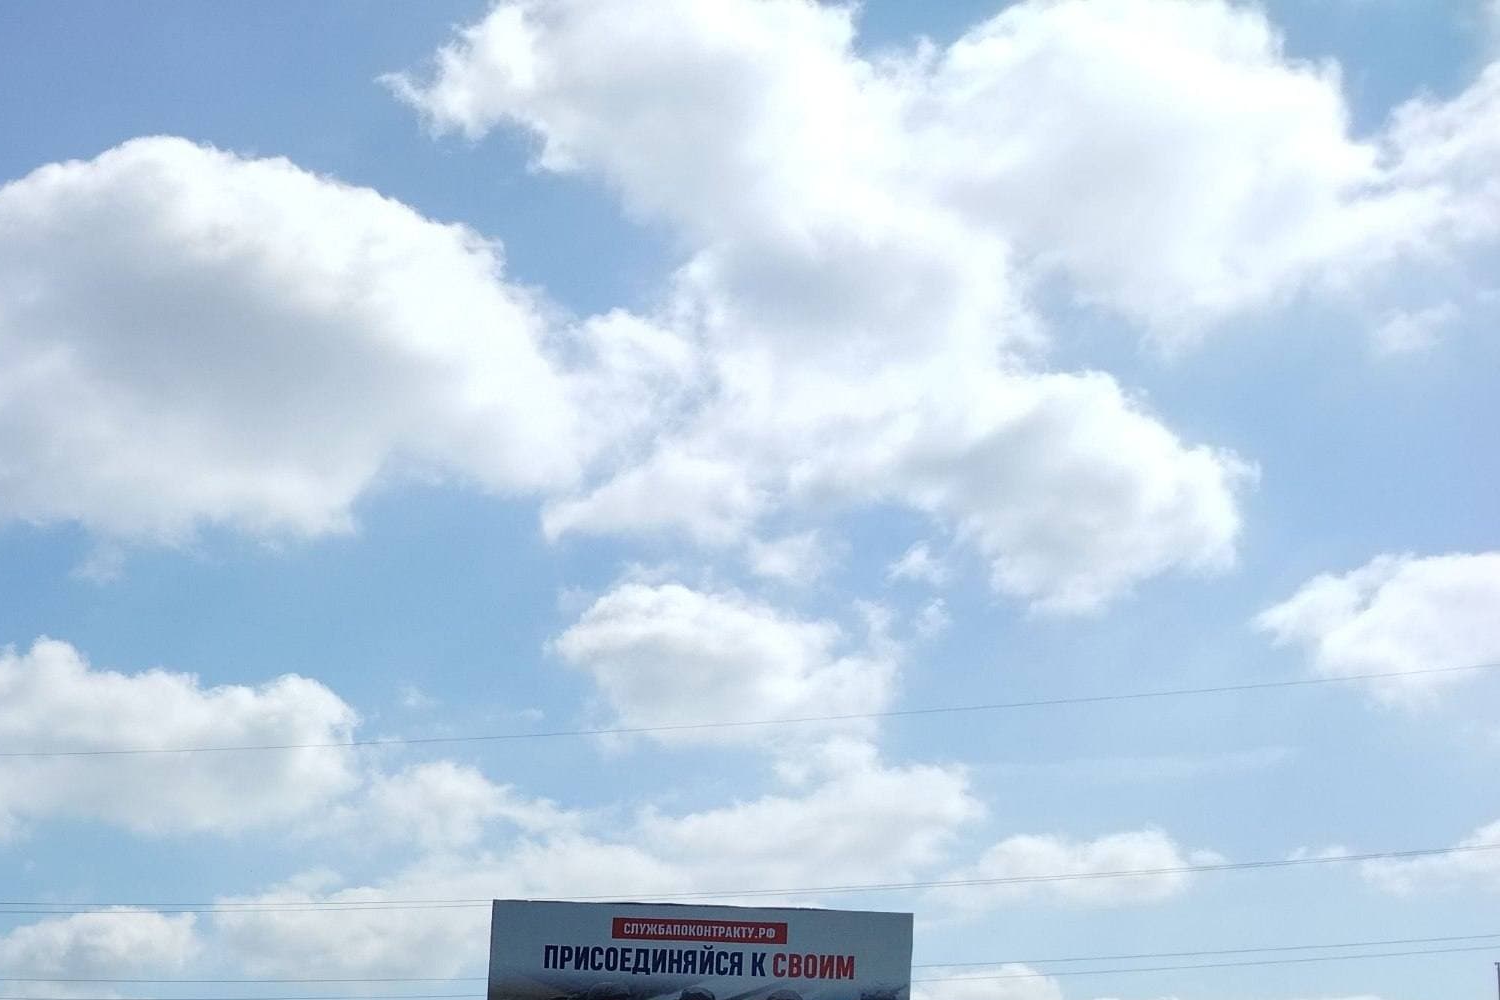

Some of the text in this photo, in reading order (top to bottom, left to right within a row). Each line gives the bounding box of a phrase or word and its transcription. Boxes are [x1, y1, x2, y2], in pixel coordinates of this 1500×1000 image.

[624, 923, 776, 939] СЛУЖБАПОКОНТРАКТУ.РФ
[544, 945, 855, 980] ПРИСОЕДИНЯЙСЯ К СВОИМ
